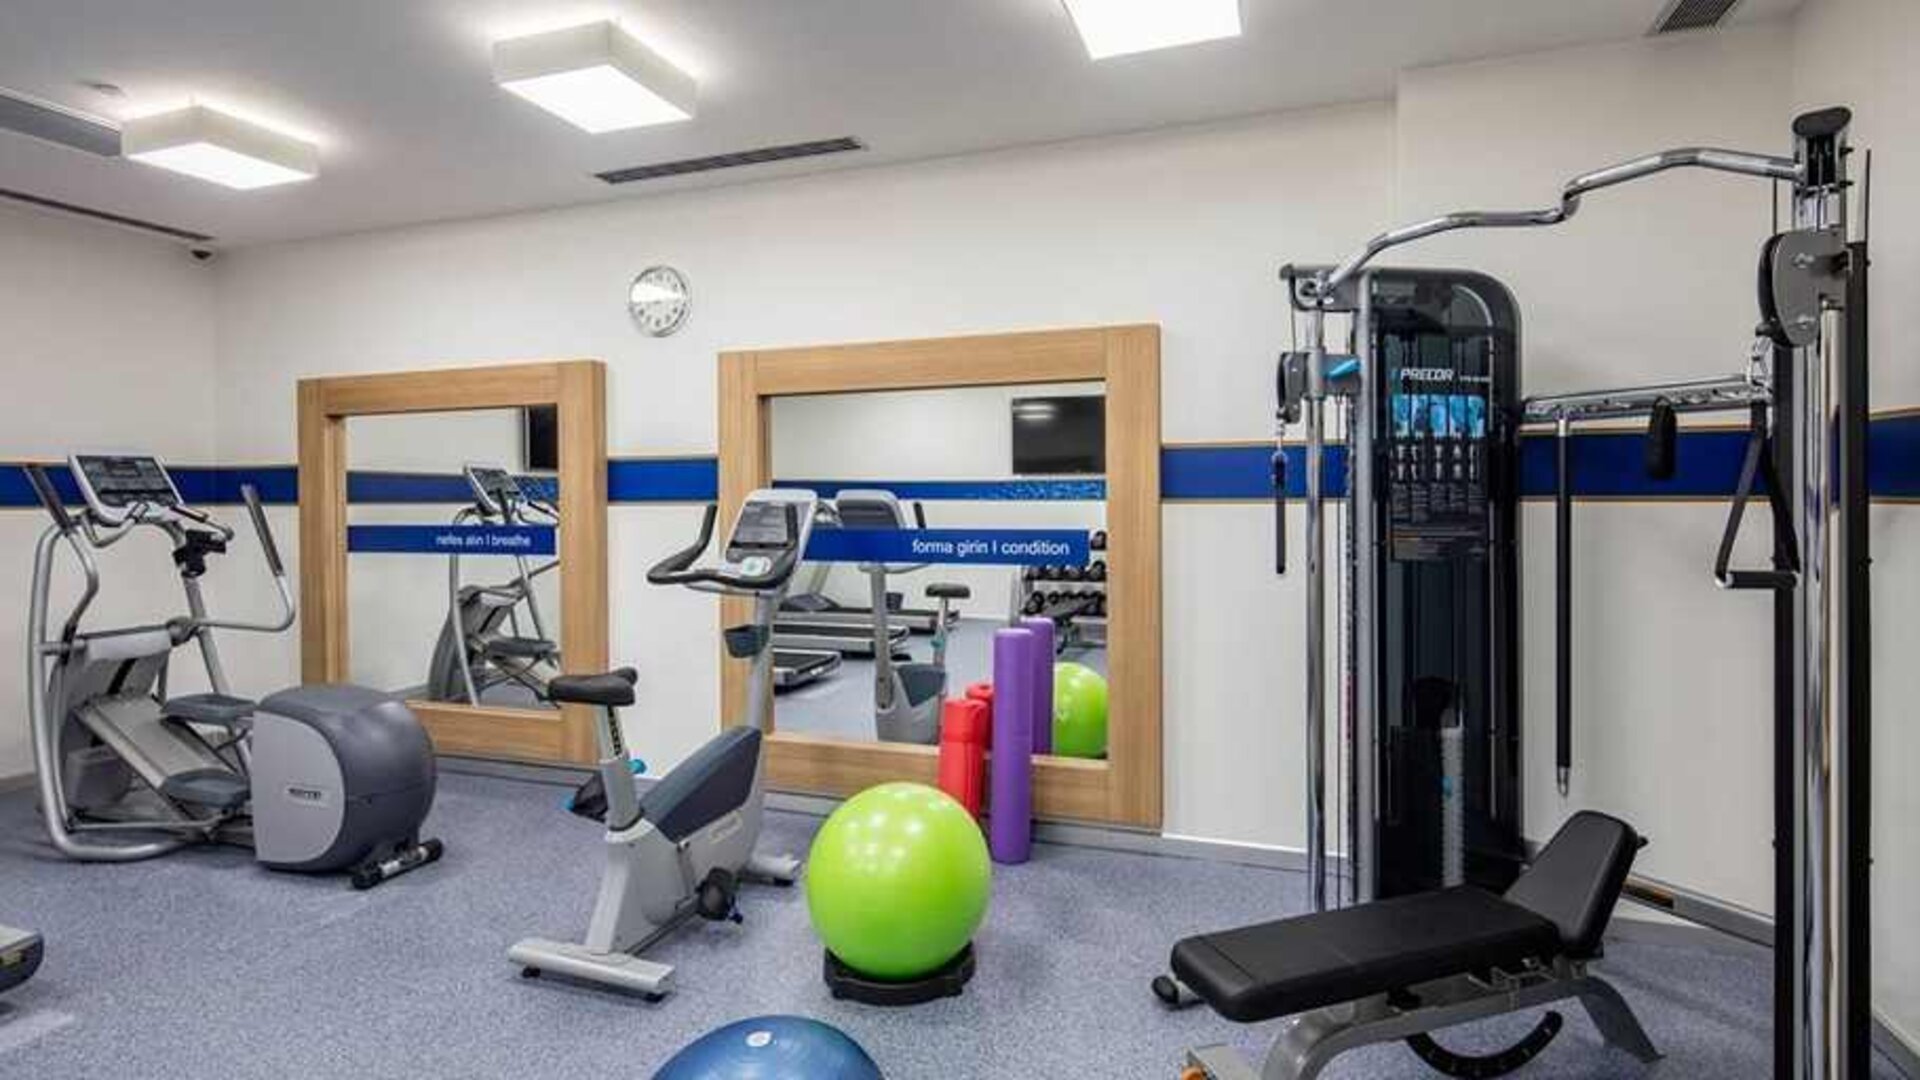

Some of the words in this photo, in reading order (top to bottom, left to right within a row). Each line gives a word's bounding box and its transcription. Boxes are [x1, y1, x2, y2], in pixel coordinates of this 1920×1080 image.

[912, 539, 954, 554] forma
[957, 539, 989, 557] girin
[1001, 540, 1071, 556] condition
